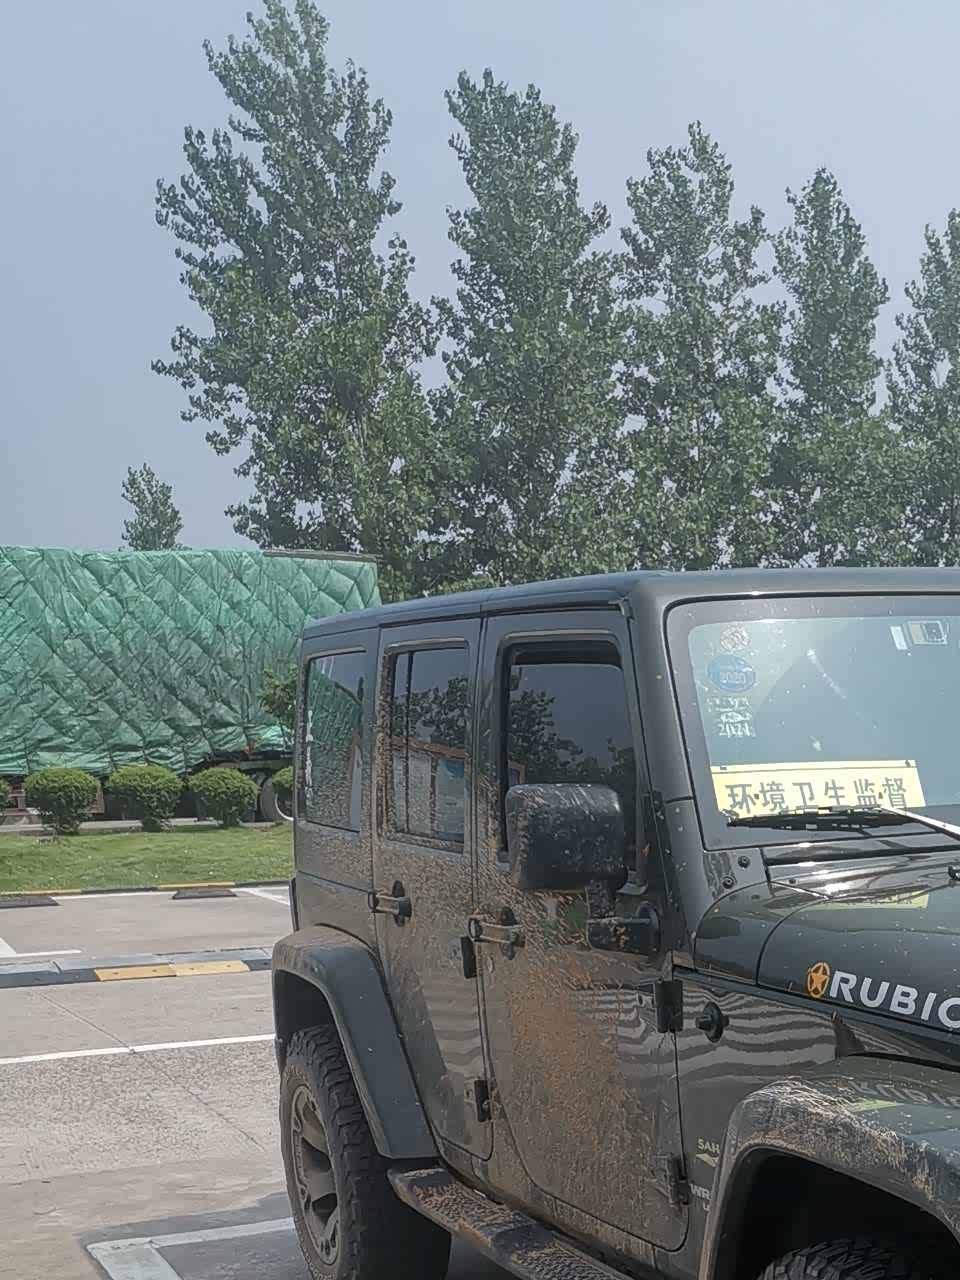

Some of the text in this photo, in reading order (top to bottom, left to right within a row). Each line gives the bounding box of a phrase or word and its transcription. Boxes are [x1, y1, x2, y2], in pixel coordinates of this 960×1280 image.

[725, 776, 907, 814] 环境卫生监督
